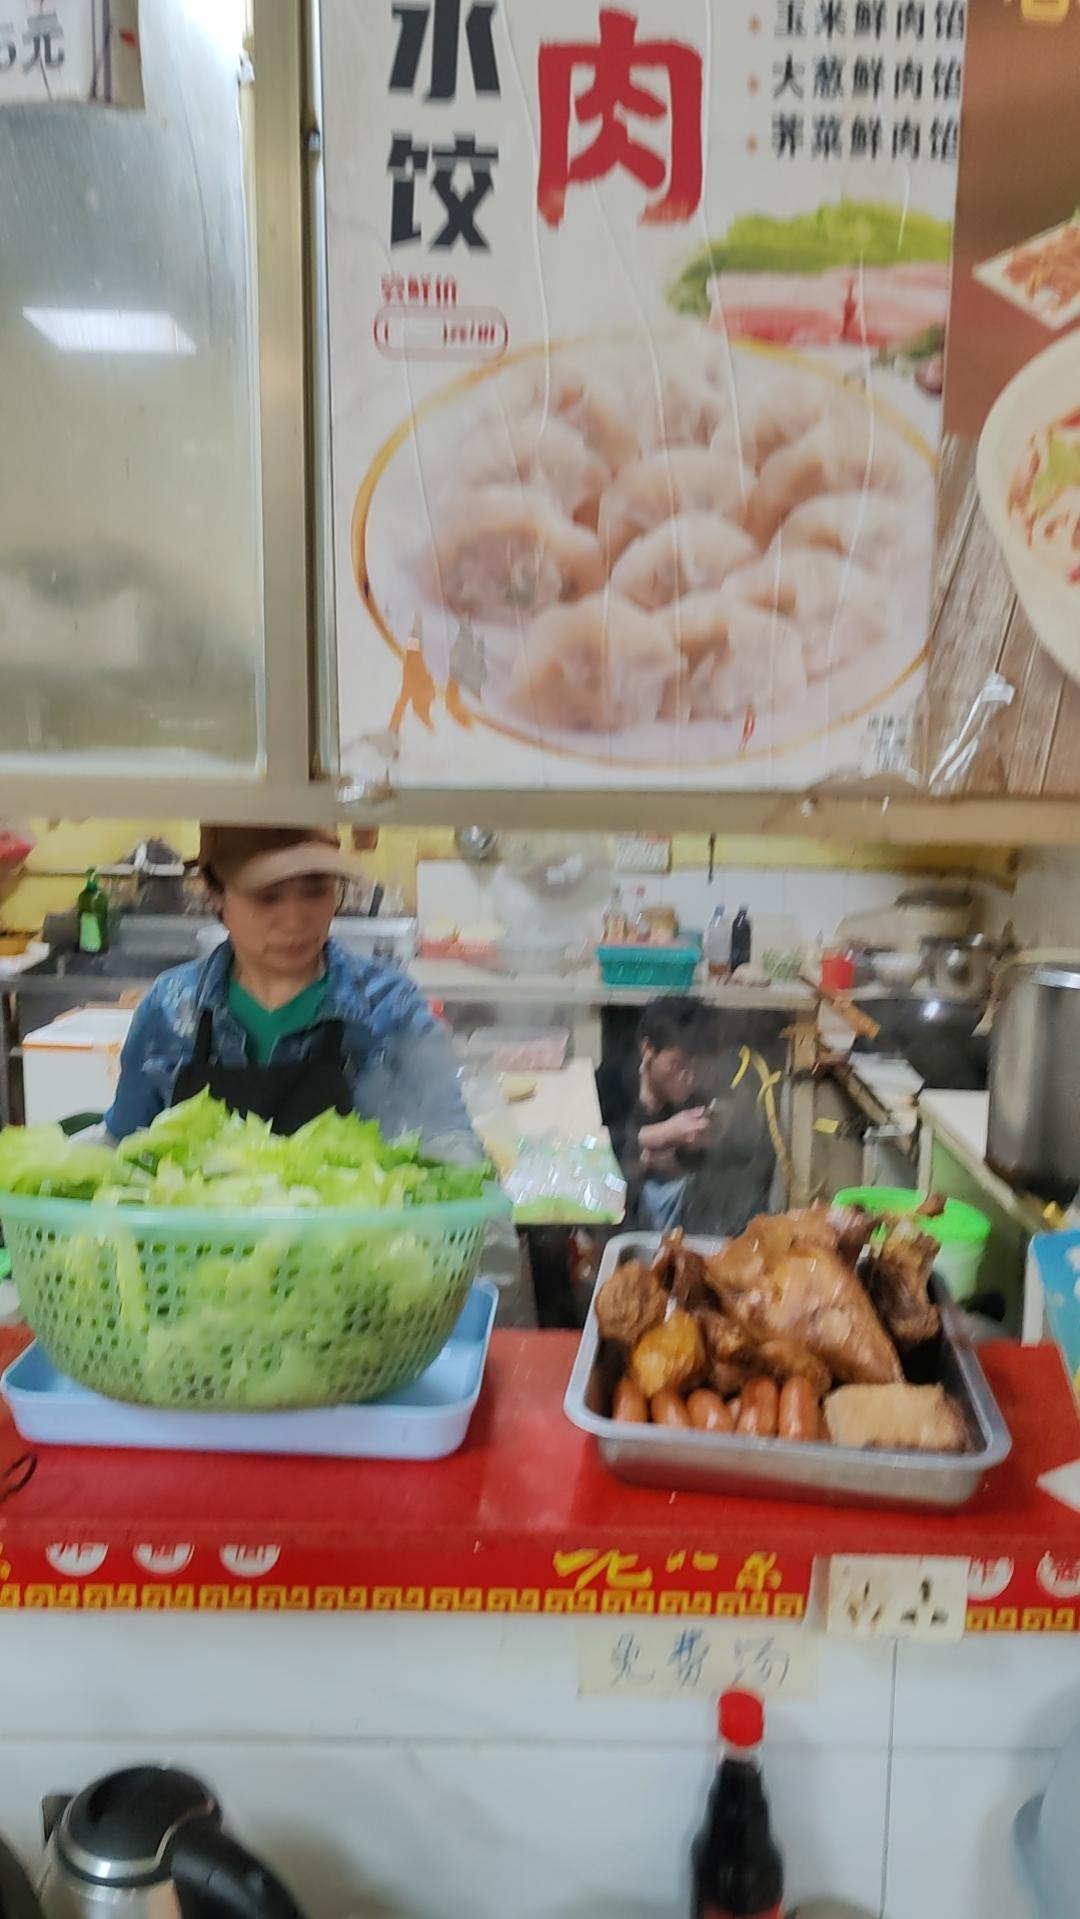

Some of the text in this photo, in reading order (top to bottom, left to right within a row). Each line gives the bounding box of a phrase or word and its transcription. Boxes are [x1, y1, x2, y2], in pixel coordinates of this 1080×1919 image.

[388, 0, 500, 253] 水饺
[537, 7, 703, 231] 肉
[772, 53, 961, 101] 大葱鲜肉馅
